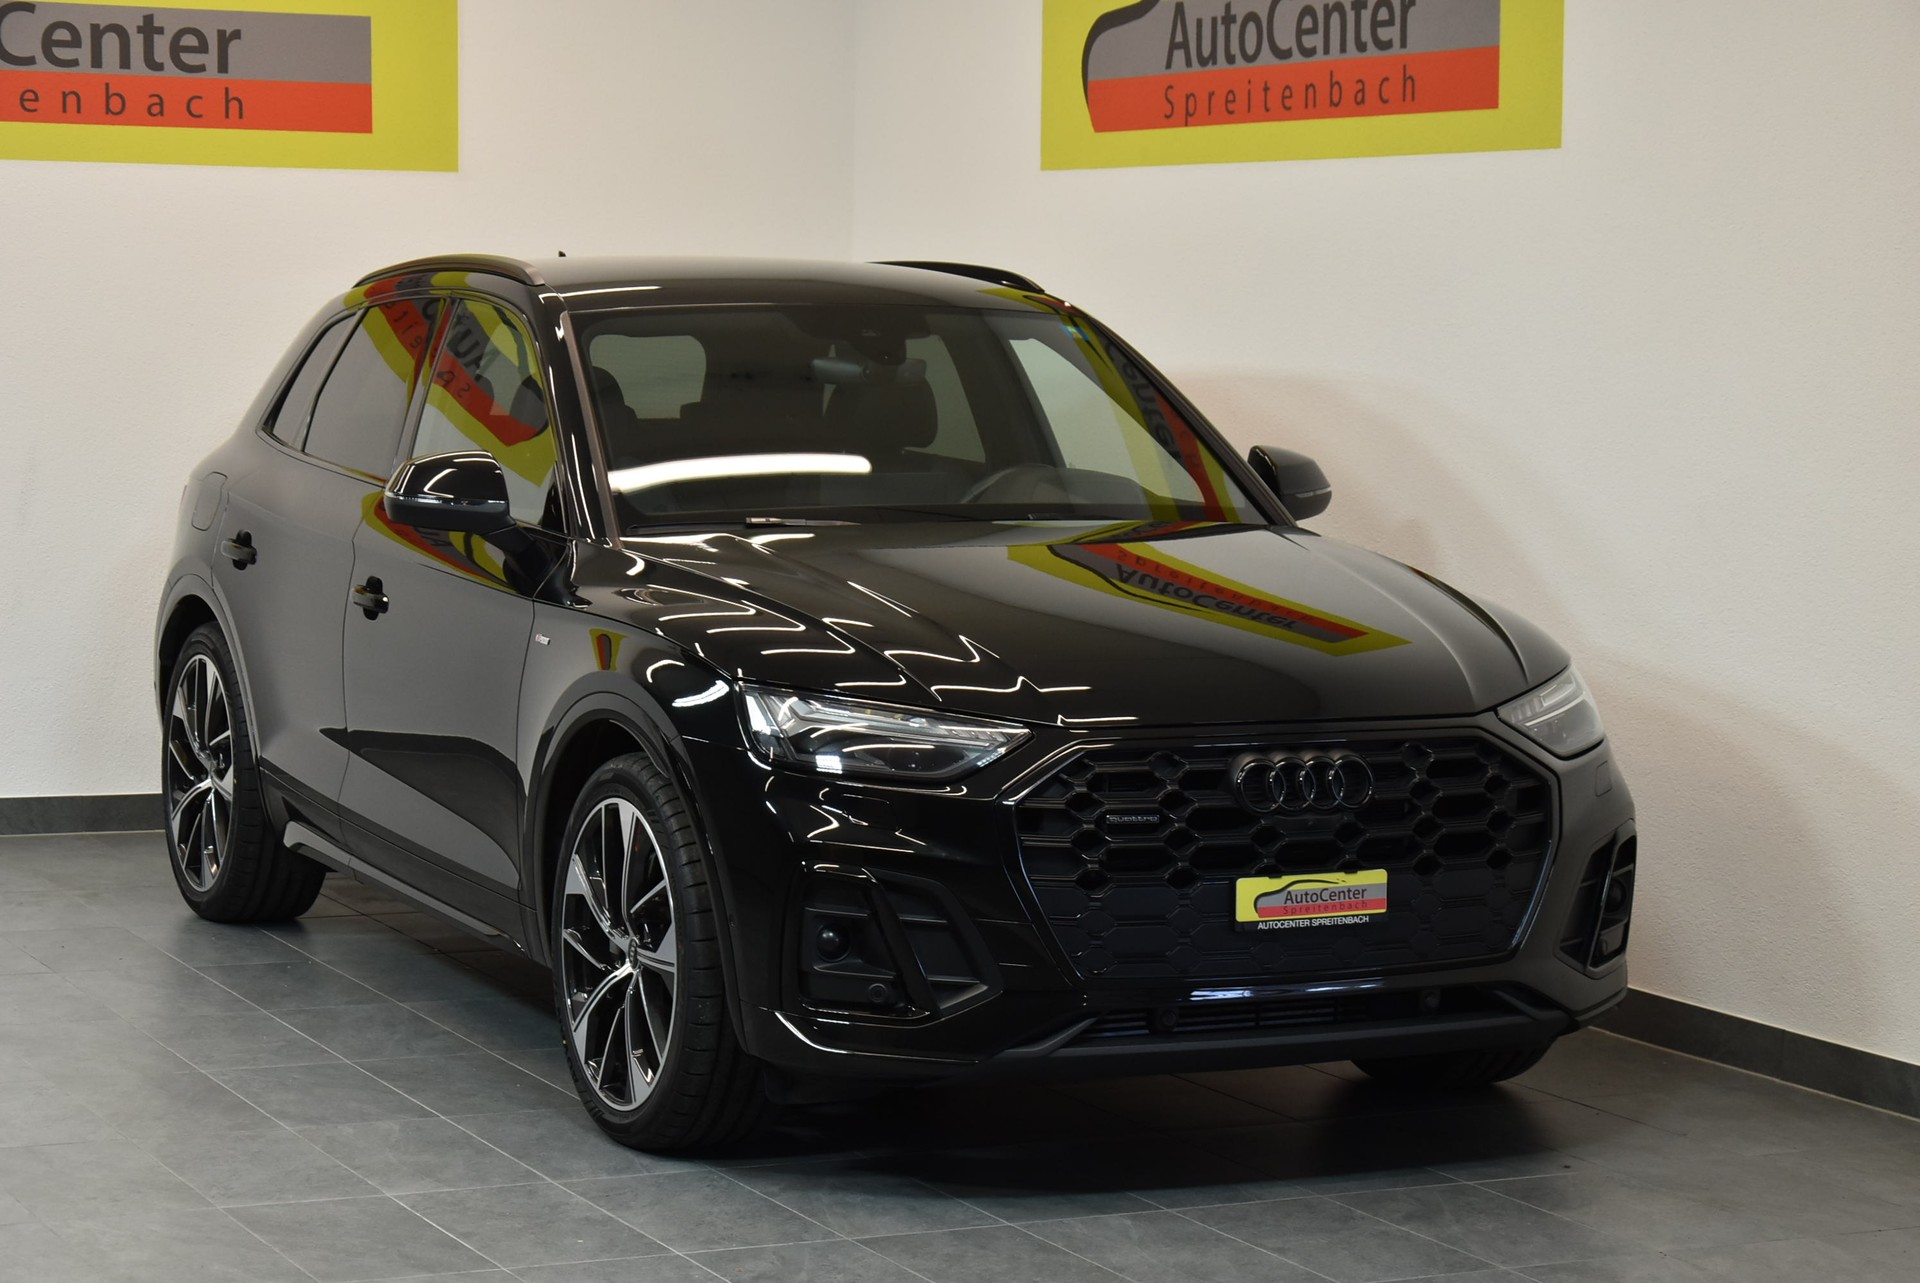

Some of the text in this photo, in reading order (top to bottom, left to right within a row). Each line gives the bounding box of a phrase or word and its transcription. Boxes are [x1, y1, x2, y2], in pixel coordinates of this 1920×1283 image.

[0, 1, 242, 74] Center
[1164, 0, 1416, 70] AutoCenter
[19, 82, 244, 120] enbach
[1164, 64, 1416, 127] Spreitenbach
[1283, 888, 1367, 905] AutoCenter
[1283, 900, 1368, 916] Spreitenbach
[1257, 915, 1369, 930] AUTOCENTER SPREITENBACH
